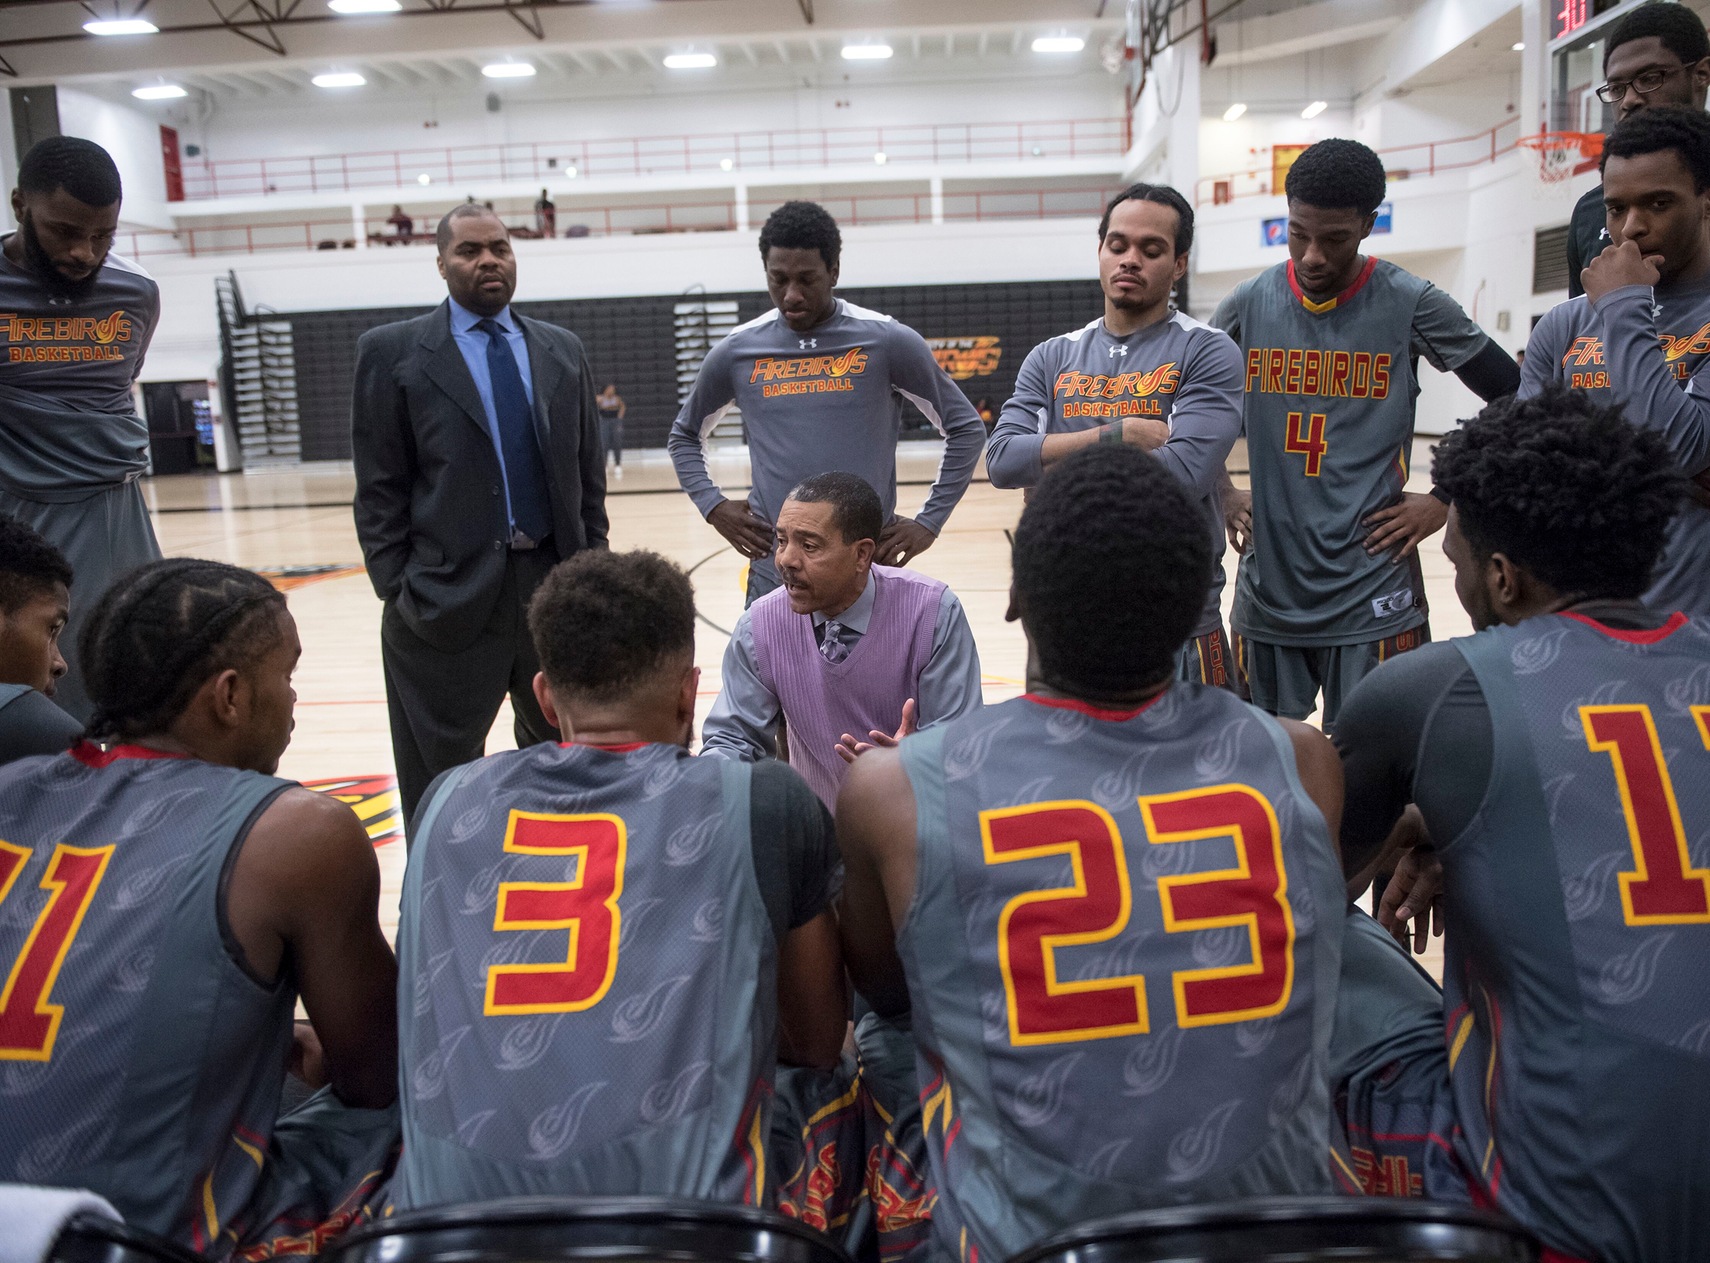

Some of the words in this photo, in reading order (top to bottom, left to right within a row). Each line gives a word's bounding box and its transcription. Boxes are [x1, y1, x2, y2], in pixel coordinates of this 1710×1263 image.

[9, 345, 124, 362] BASKETBALL
[750, 347, 868, 383] FIREBIRDS
[763, 378, 854, 397] BASKETBALL
[1053, 362, 1181, 400] FIREBIRDS
[1245, 348, 1391, 399] FIREBIRDS
[1063, 399, 1162, 418] BASKETBALL
[1285, 412, 1327, 476] 4
[483, 808, 628, 1016] 3
[978, 783, 1296, 1046] 23
